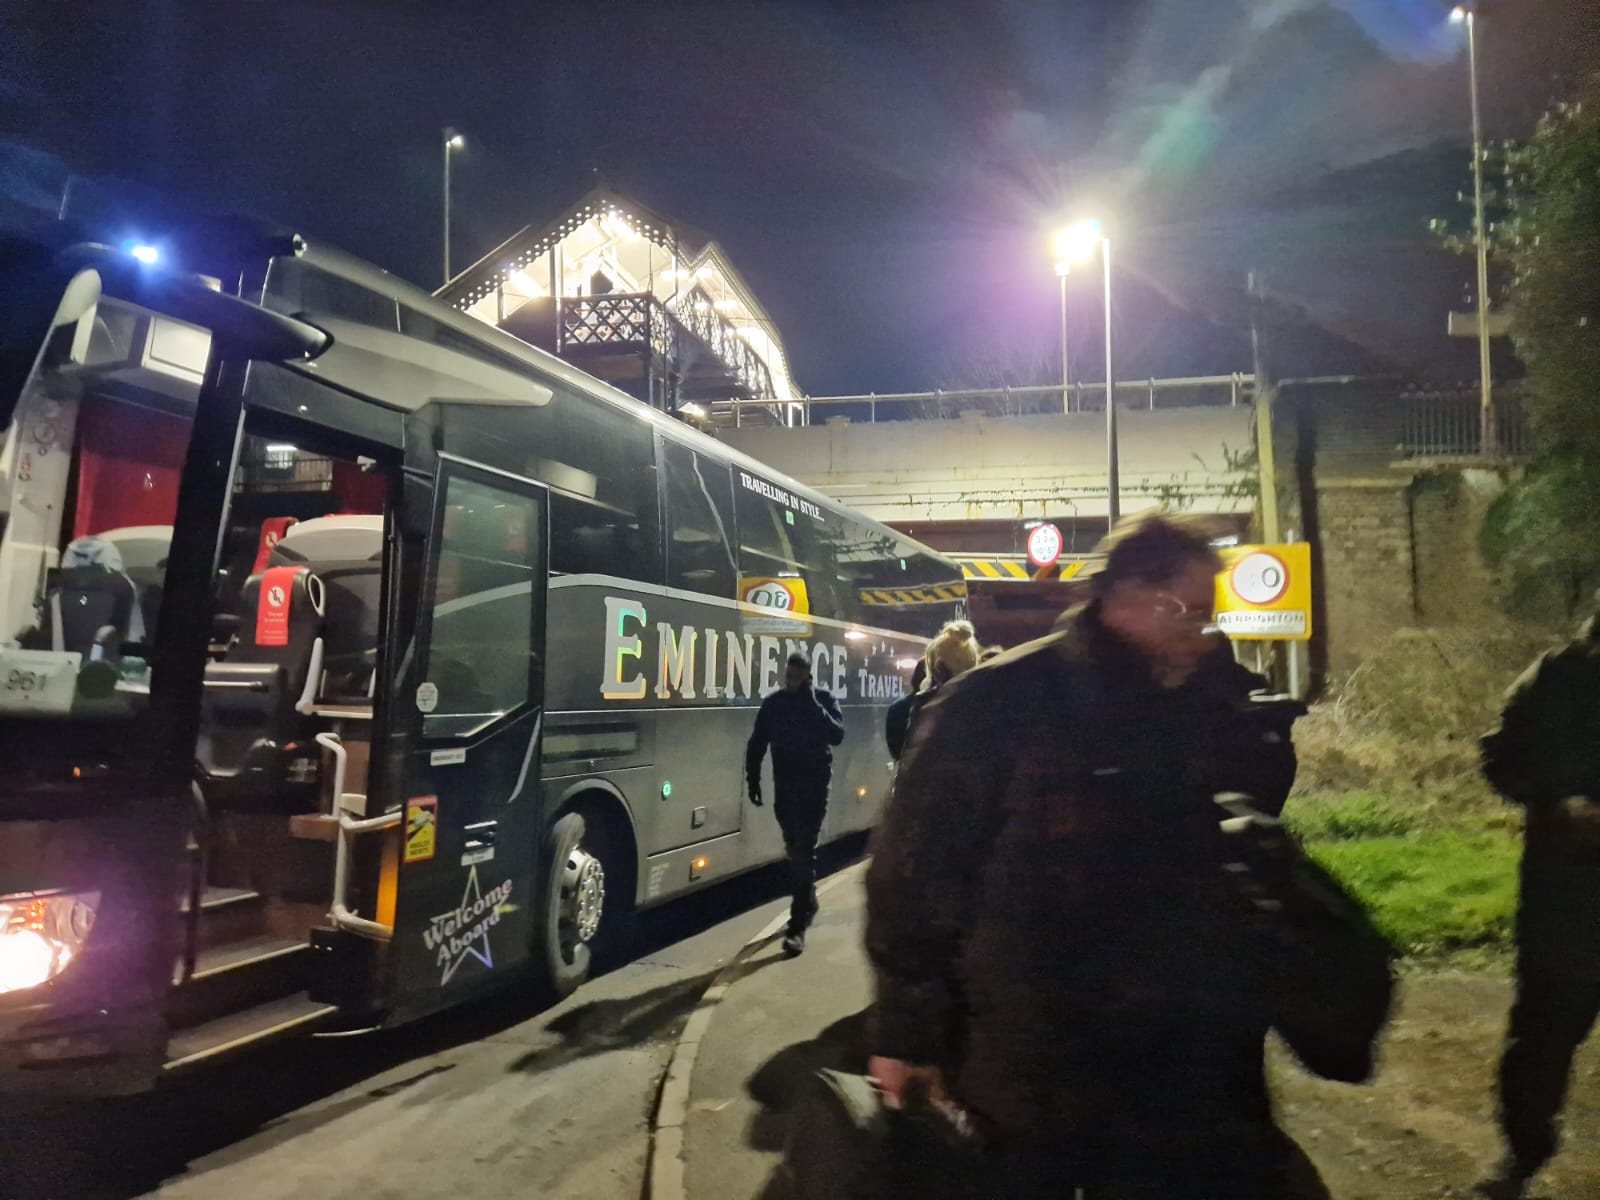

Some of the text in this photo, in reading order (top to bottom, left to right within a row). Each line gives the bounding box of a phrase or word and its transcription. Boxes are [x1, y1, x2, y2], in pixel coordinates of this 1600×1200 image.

[740, 472, 789, 506] TRAVELLING
[790, 495, 799, 510] IN
[858, 668, 904, 698] TRAVEL
[423, 879, 512, 950] Welcome
[437, 907, 500, 967] Aboard
